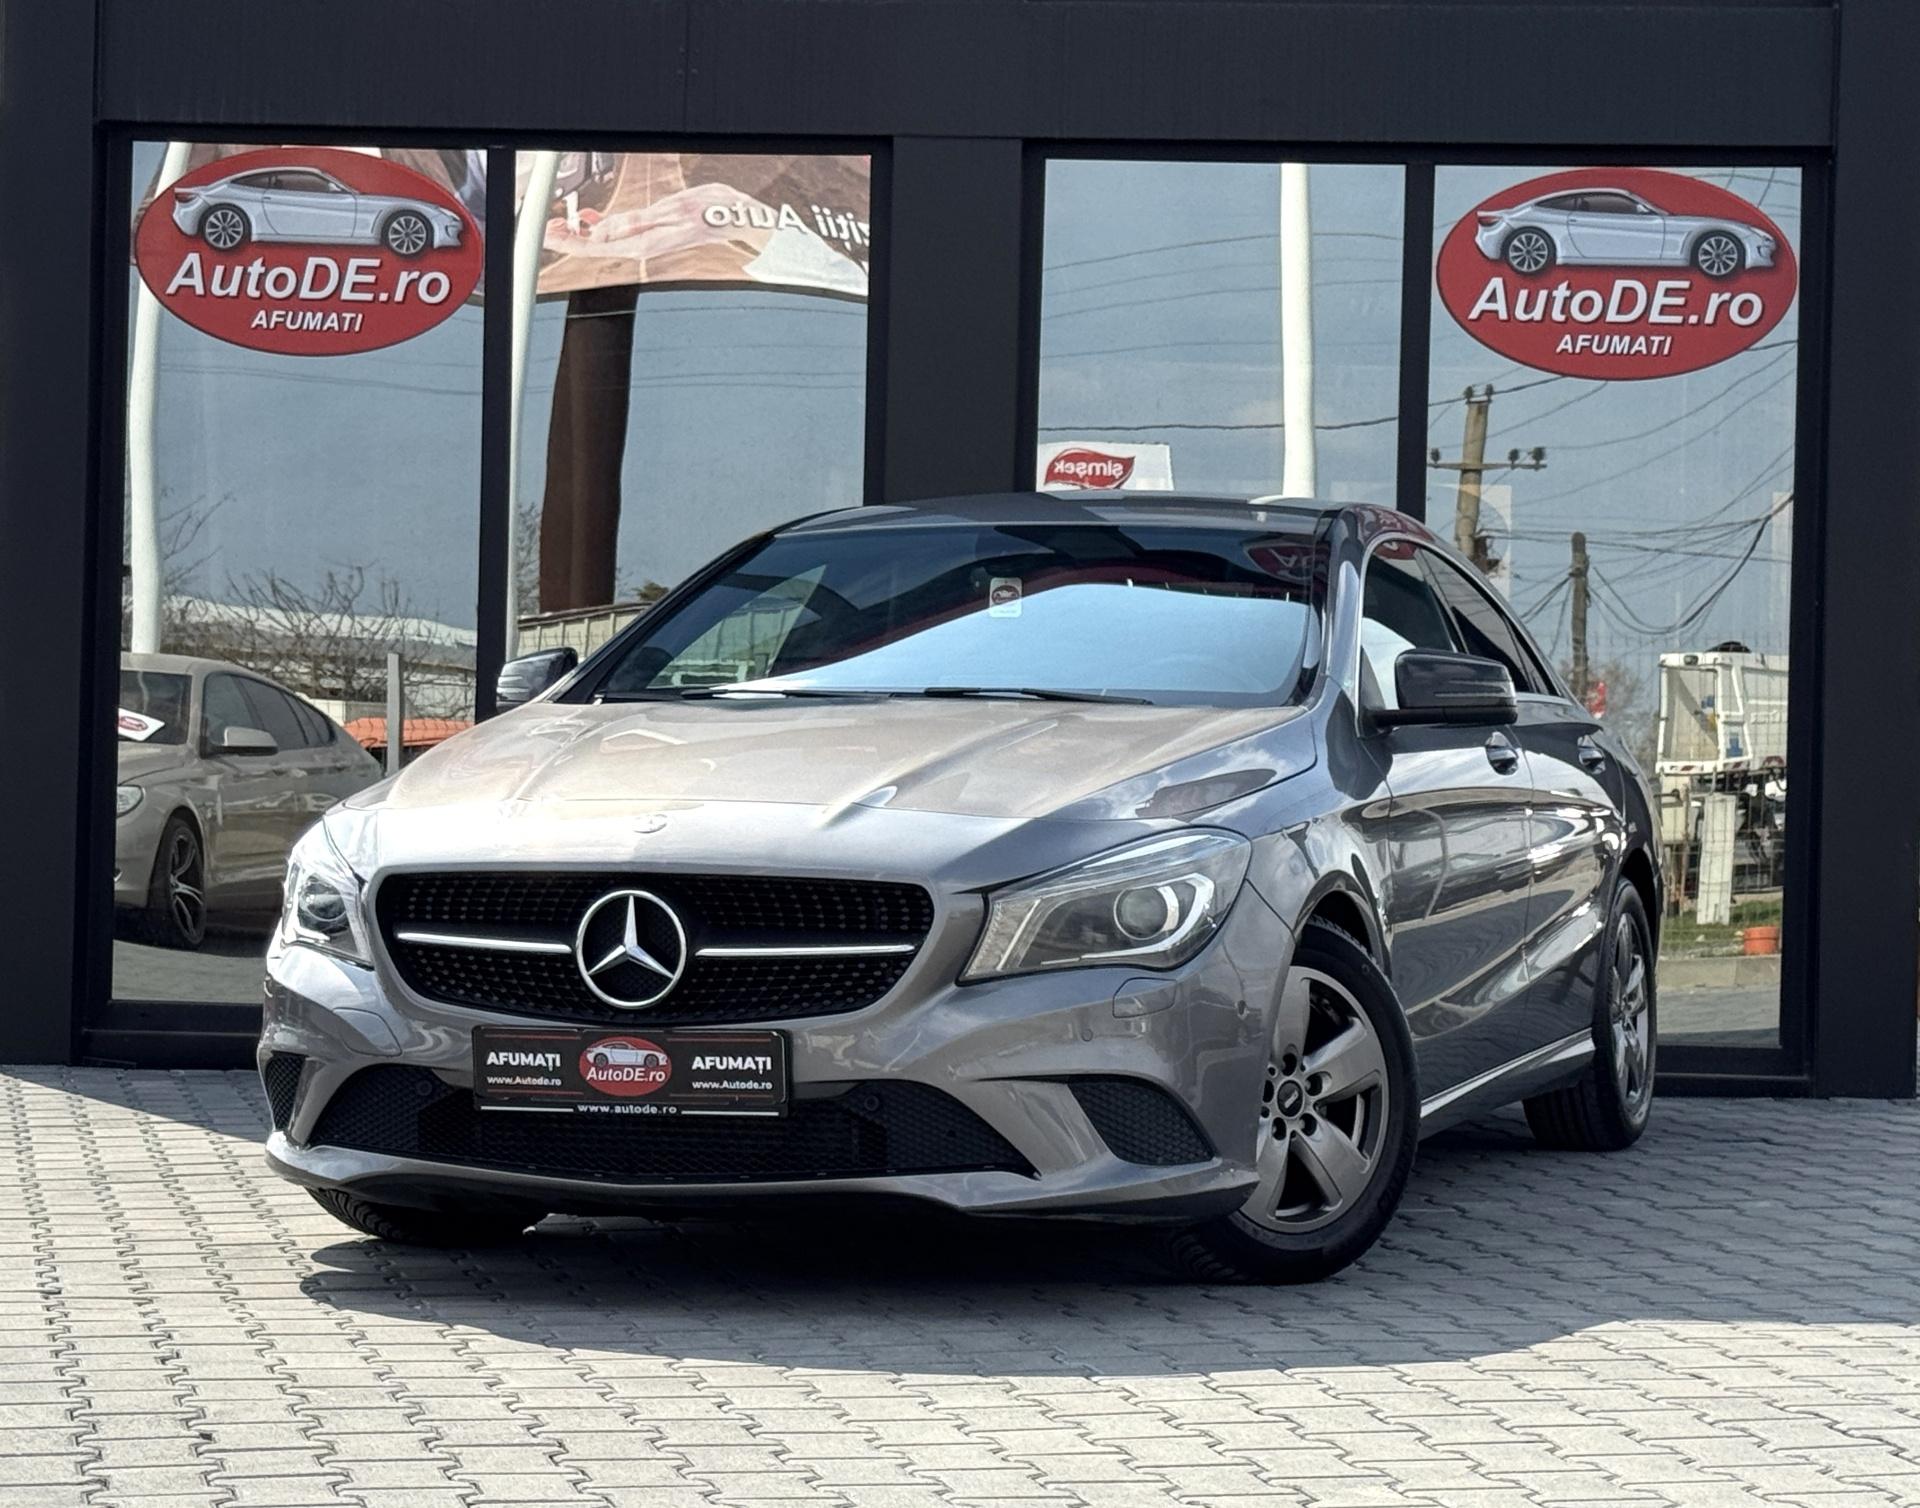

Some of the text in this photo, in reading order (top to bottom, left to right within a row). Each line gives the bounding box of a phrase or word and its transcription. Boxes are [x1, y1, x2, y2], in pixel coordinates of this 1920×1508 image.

[166, 252, 452, 305] AutoDE.ro
[1468, 277, 1765, 327] AutoDE.ro
[251, 309, 364, 333] AFUMATI
[1556, 334, 1673, 356] AFUMATI
[486, 1051, 561, 1072] AFUMAȚI
[691, 1056, 772, 1075] AFUMAȚI
[487, 1075, 562, 1087] www.Autode.ro
[586, 1066, 666, 1082] AutoDE.ro
[692, 1079, 773, 1090] www.Autode.ro
[577, 1103, 678, 1115] www.autode.ro
